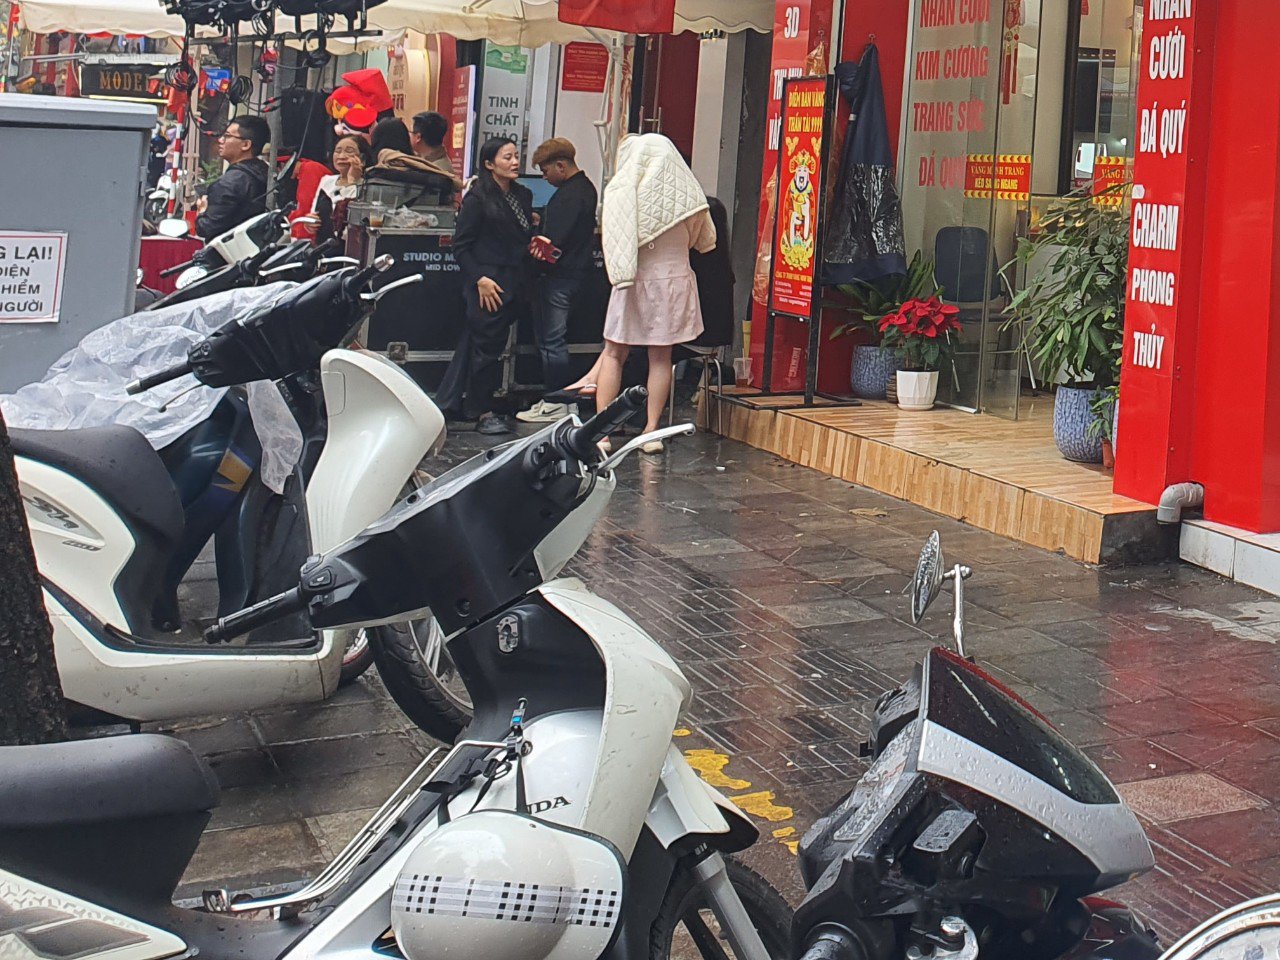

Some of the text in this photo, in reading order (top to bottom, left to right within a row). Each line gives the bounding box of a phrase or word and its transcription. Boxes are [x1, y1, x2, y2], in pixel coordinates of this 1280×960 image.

[784, 6, 800, 39] 3D
[915, 44, 989, 81] KIM CƯƠNG
[1149, 25, 1186, 79] CƯỚI
[485, 111, 519, 126] CHẤT
[913, 95, 985, 132] TRANG SỨC
[1140, 100, 1186, 158] ĐÁ QUÝ
[918, 149, 936, 187] ĐÁ
[1133, 202, 1179, 251] CHARM
[14, 246, 53, 264] LẠI!
[403, 252, 442, 261] STUDIO
[1, 278, 41, 294] HIỂM
[1131, 268, 1175, 306] PHONG
[1133, 323, 1165, 370] THỦY
